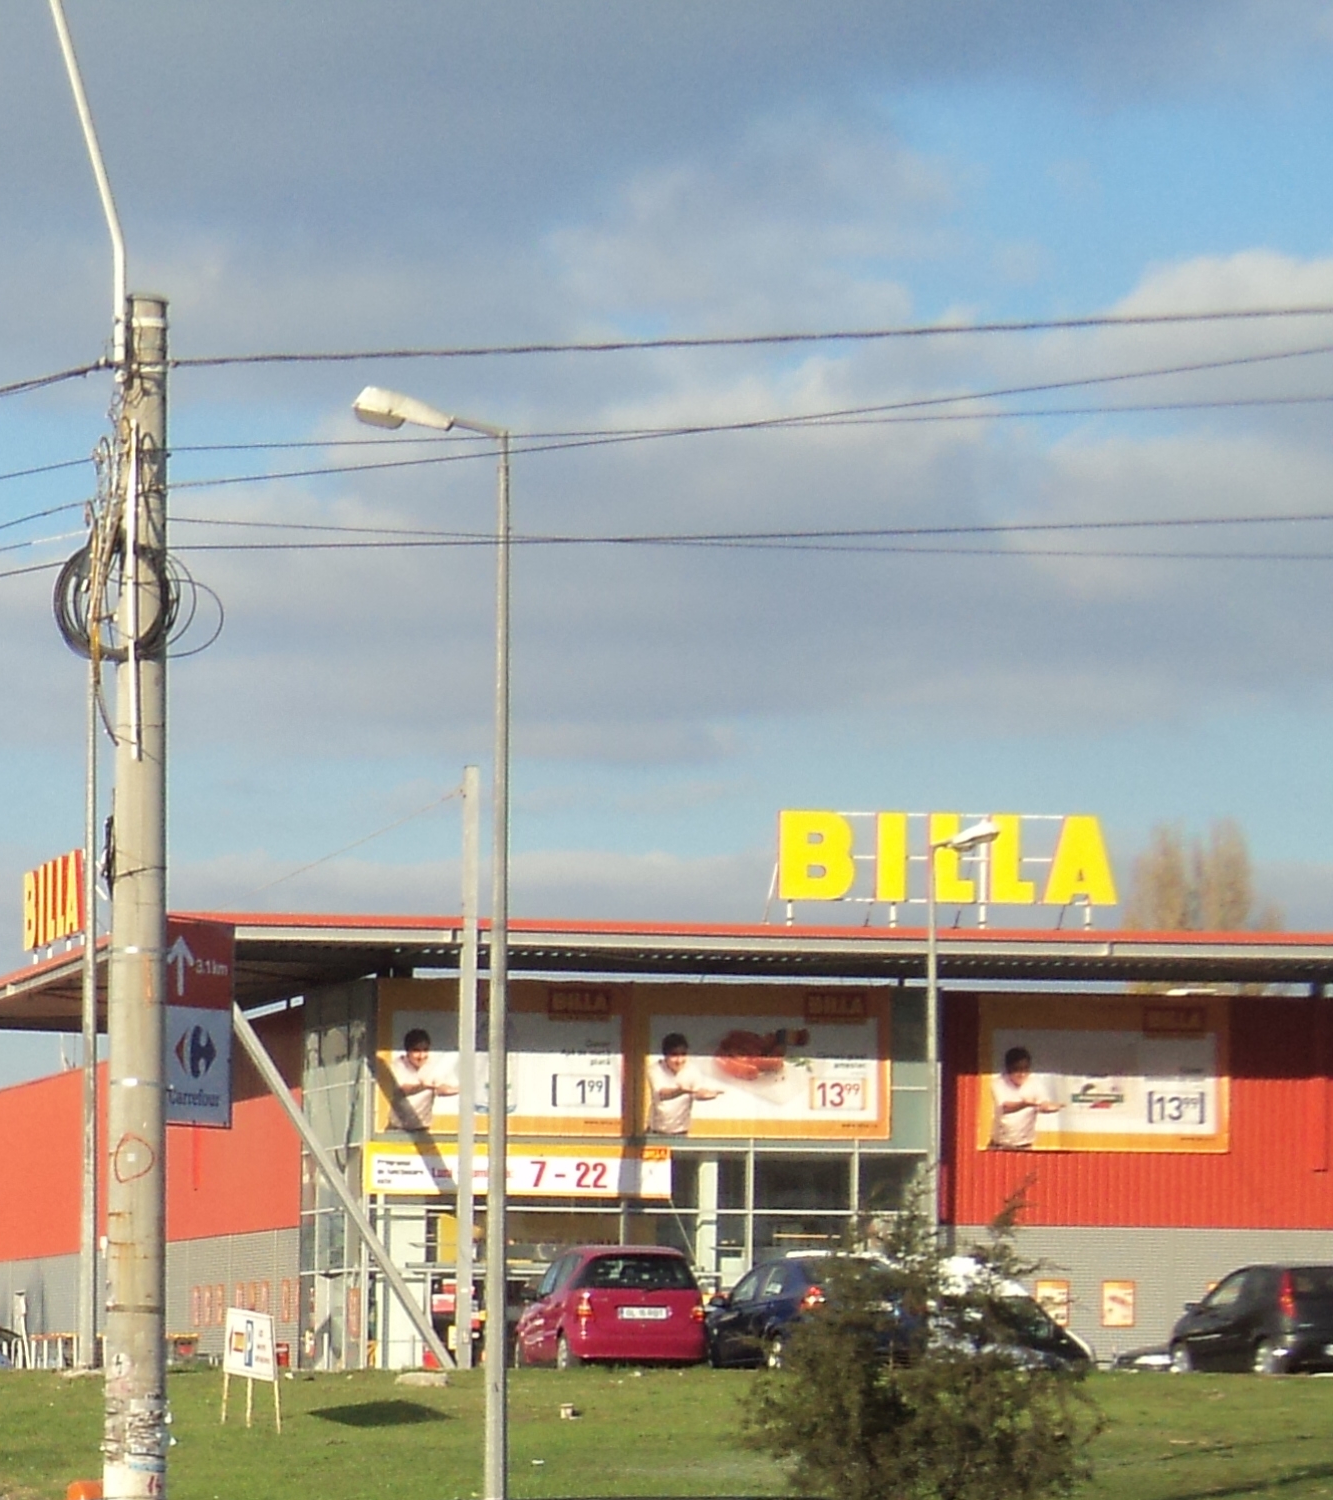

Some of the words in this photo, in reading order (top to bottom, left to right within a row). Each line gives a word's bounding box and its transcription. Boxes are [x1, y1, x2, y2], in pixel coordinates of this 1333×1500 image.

[24, 849, 81, 952] BILLA
[777, 810, 1118, 905] BILLA
[530, 1160, 547, 1187] 7
[575, 1162, 608, 1188] 22
